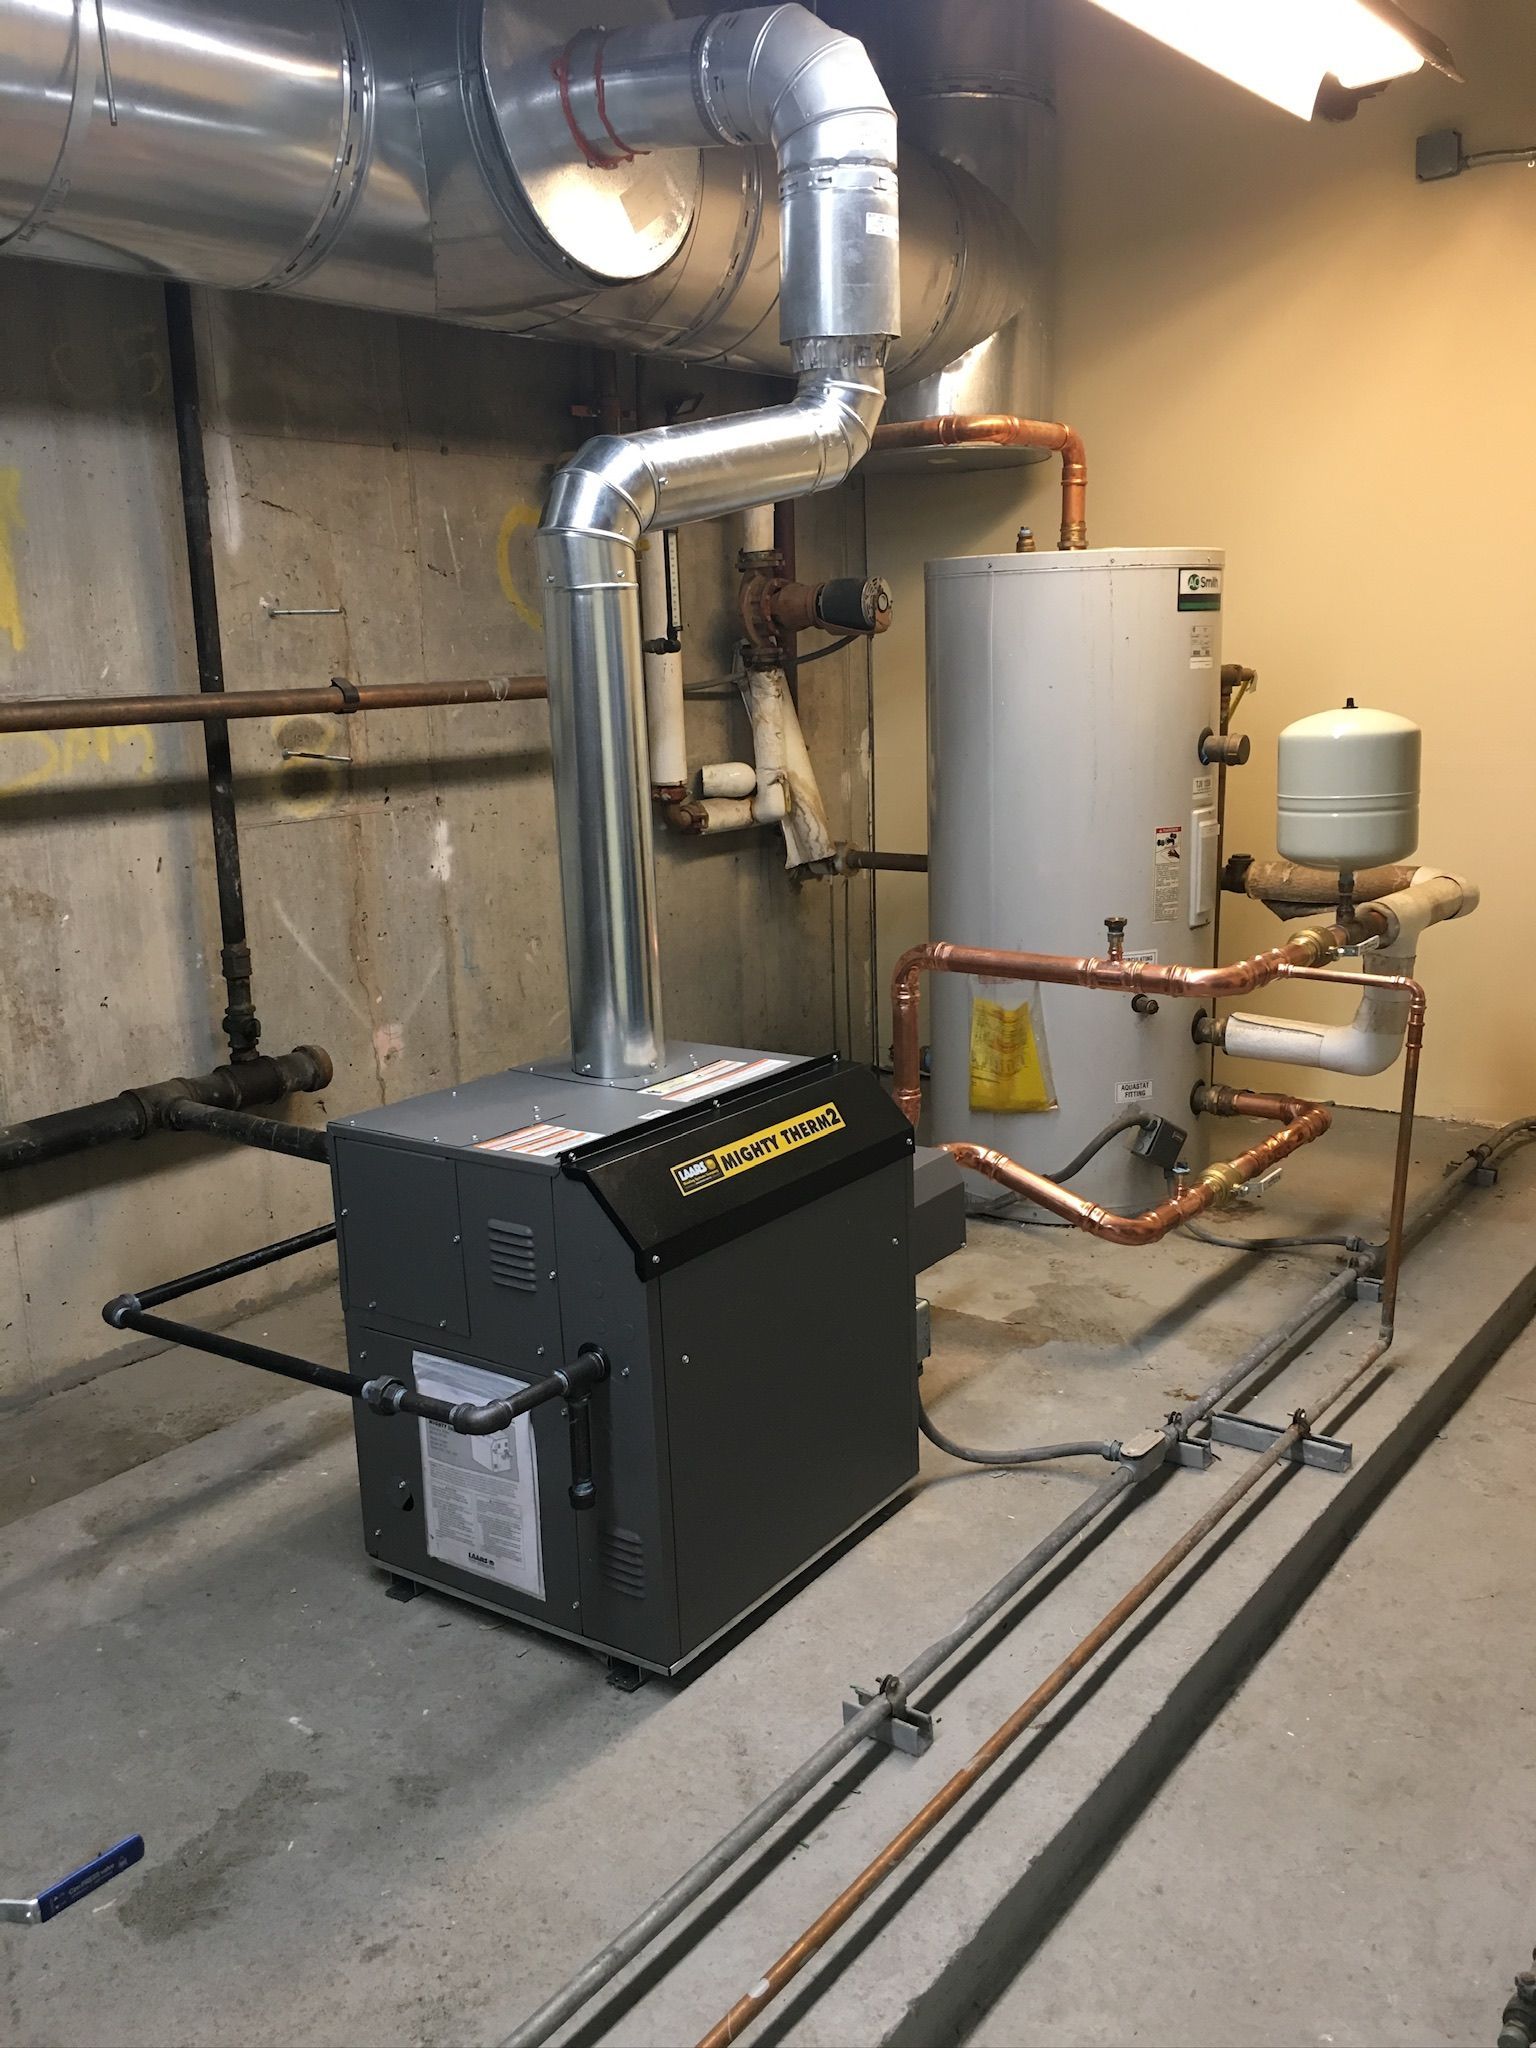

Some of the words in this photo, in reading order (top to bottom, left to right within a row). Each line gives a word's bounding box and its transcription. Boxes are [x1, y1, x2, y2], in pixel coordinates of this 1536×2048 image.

[1121, 1082, 1149, 1091] AQUASTAT
[1124, 1090, 1146, 1098] FITTING
[720, 1134, 780, 1170] MIGHTY
[780, 1108, 841, 1144] THERM2
[677, 1161, 707, 1181] LAARS
